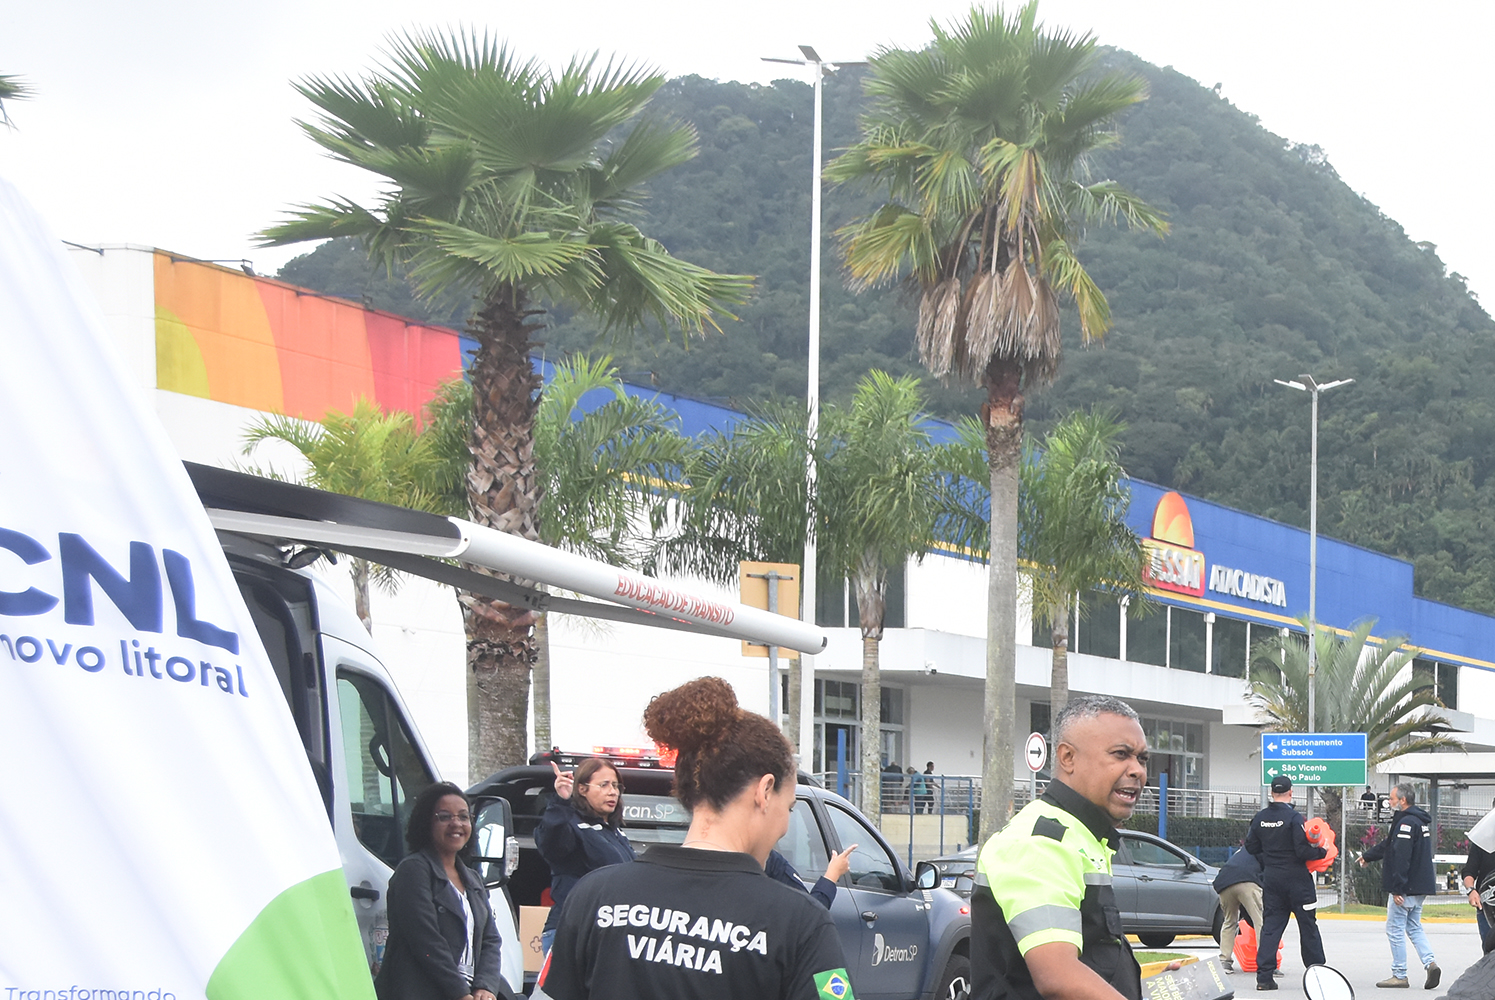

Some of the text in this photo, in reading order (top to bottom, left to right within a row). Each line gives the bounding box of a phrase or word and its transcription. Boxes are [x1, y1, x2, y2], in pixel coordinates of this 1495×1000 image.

[0, 527, 240, 655] CNL
[672, 589, 689, 613] DE
[1209, 564, 1287, 608] ATACADISTA
[120, 639, 249, 698] litoral
[1298, 773, 1321, 781] Paulo
[622, 803, 675, 820] ran.SP
[597, 904, 768, 955] SEGURANÇA
[627, 934, 723, 974] VIÁRIA
[1146, 981, 1155, 989] A
[1164, 974, 1178, 992] SEU
